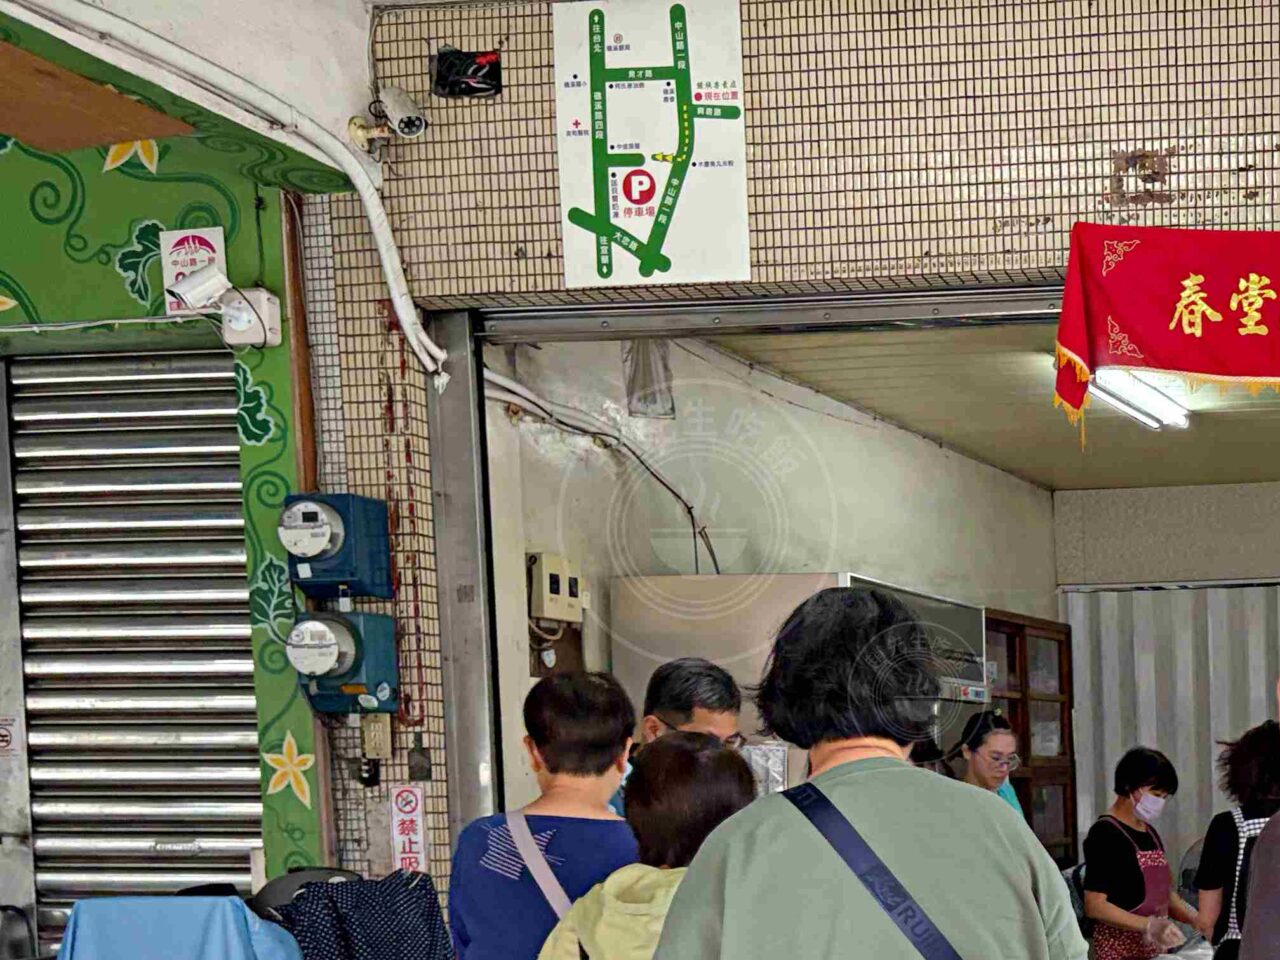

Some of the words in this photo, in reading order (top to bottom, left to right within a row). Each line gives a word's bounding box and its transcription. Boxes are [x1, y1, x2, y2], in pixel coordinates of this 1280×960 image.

[674, 21, 687, 70] 中山路一段
[704, 91, 739, 101] 現在位置
[631, 175, 651, 200] P
[623, 206, 656, 217] 停車場
